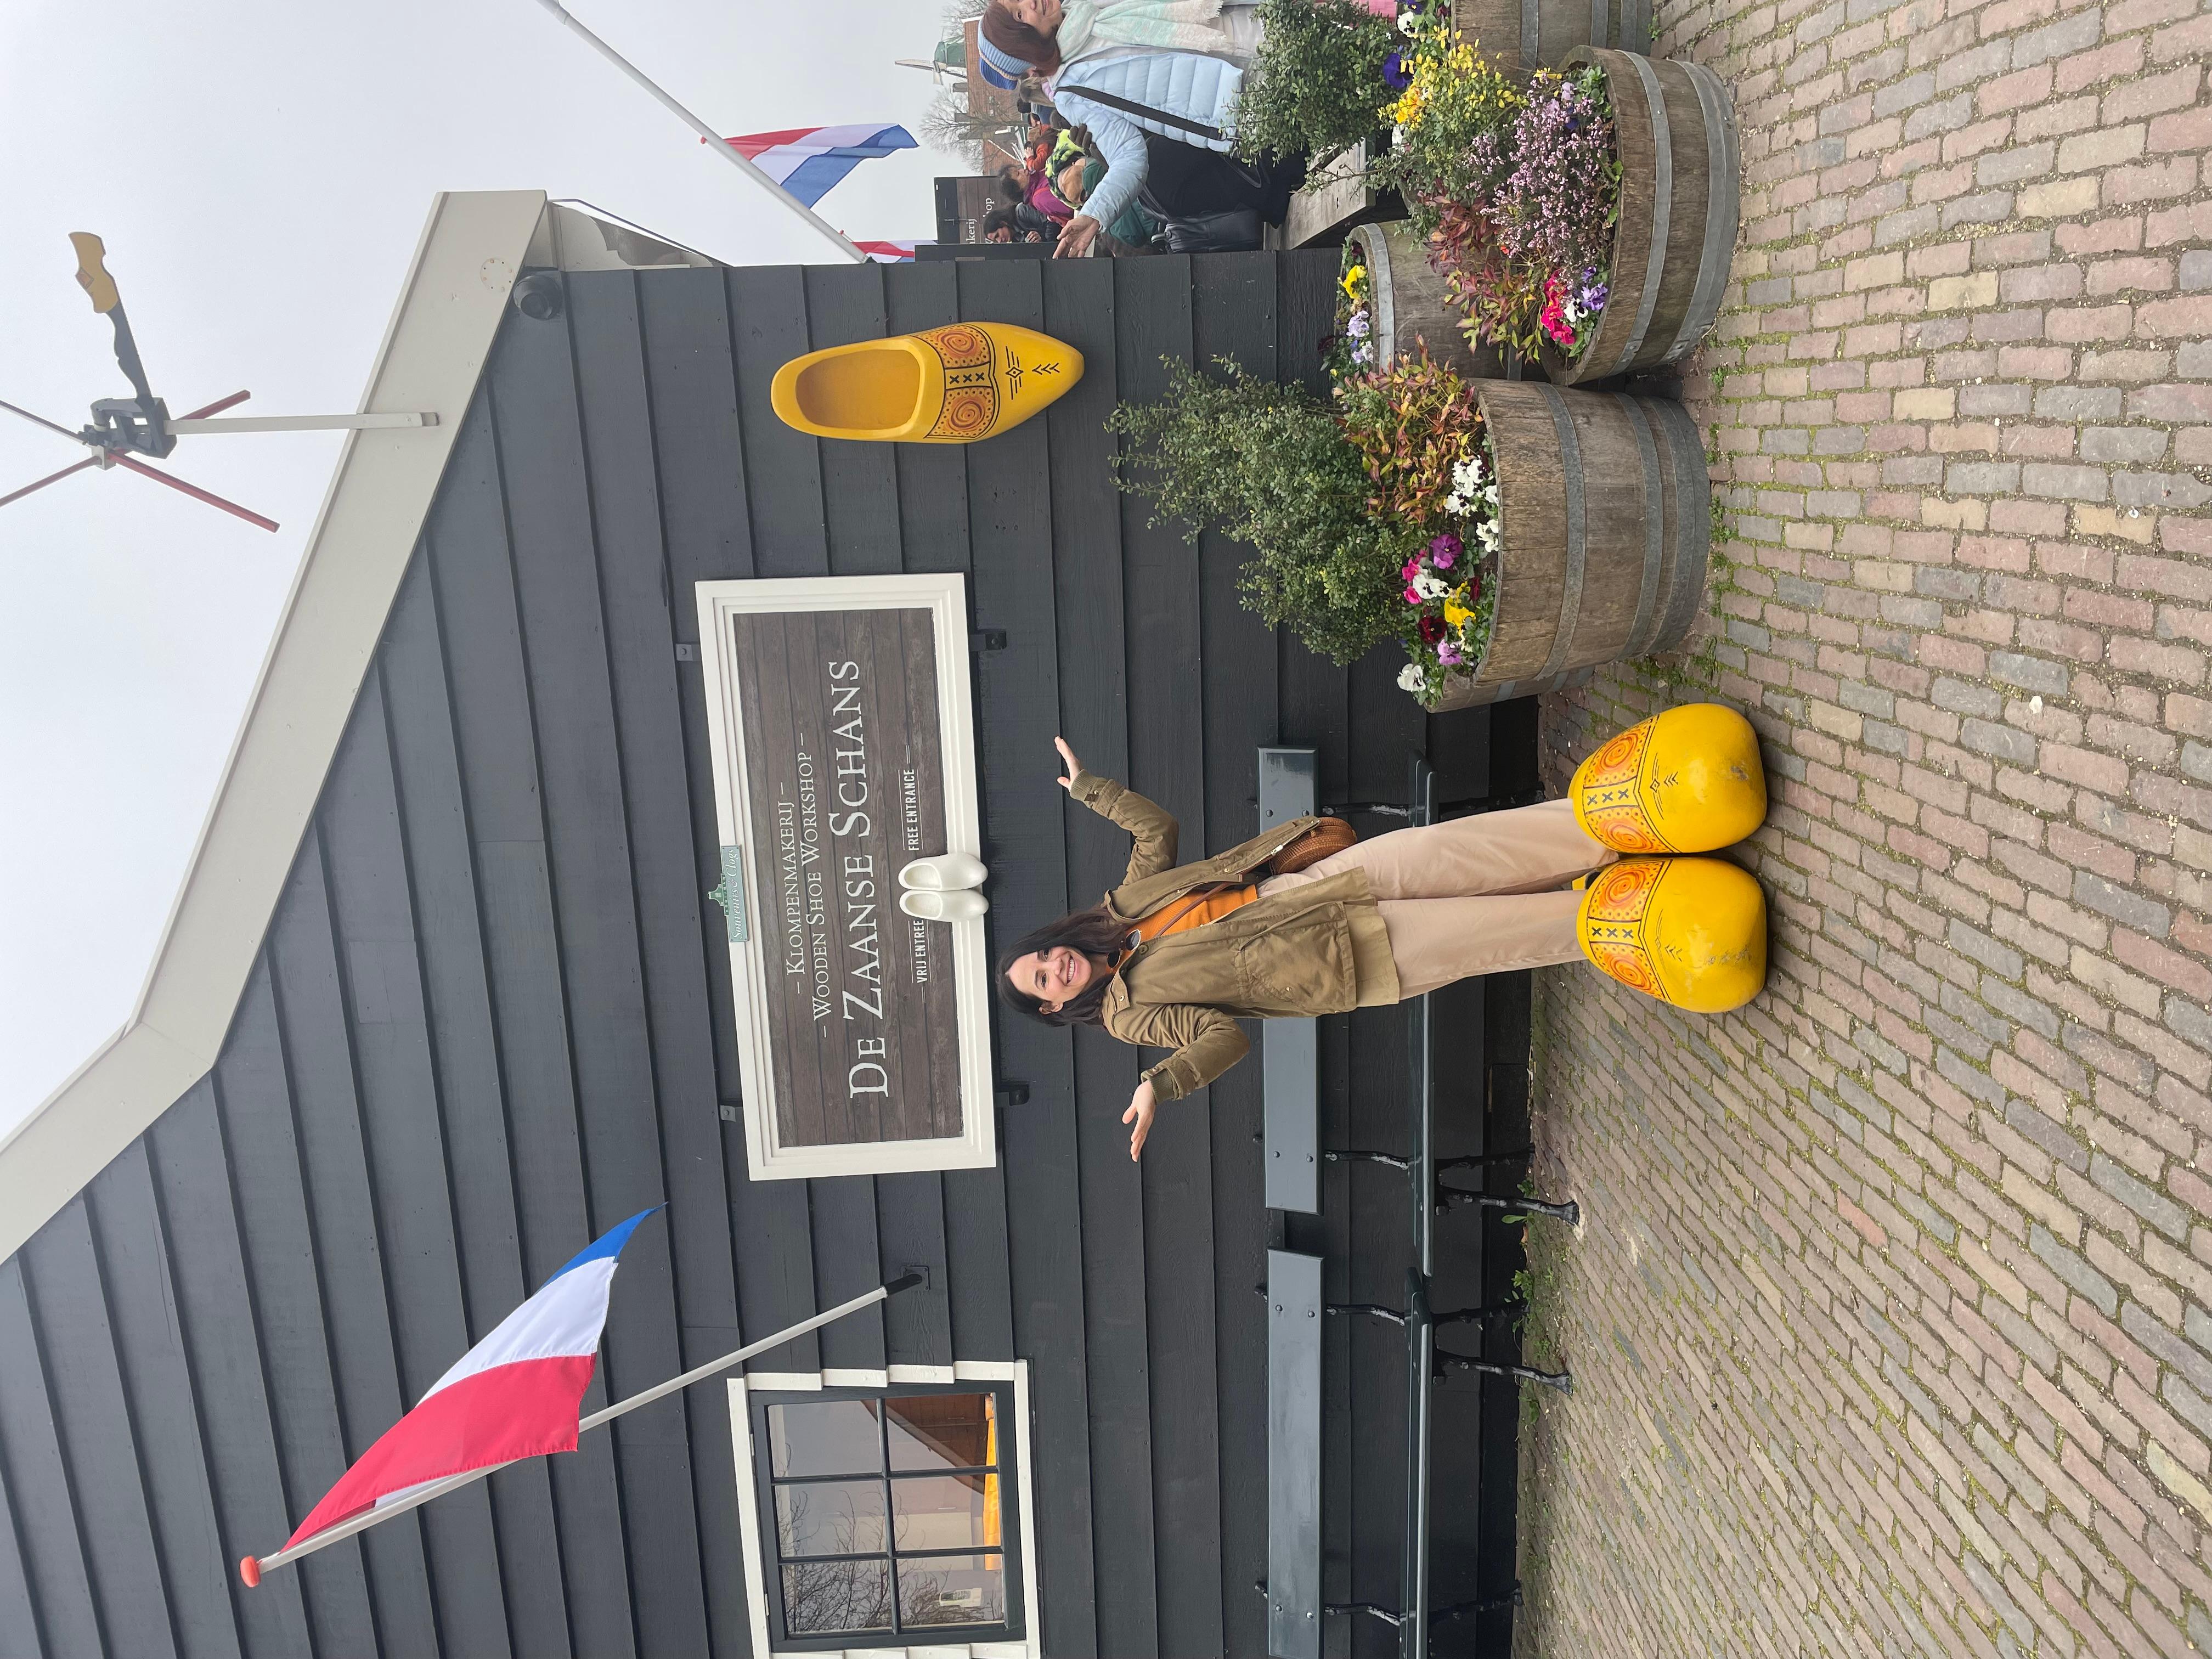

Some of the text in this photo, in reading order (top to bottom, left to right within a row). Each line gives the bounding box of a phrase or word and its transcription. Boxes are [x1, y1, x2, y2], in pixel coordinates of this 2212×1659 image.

[903, 769, 919, 851] FREE ENTRANCE
[725, 850, 738, 877] Clogs
[777, 800, 805, 975] KLOMPENMAKERIJ
[798, 752, 832, 1022] WOODEN SHOE WORKSHOP
[828, 661, 889, 1099] DE ZAANSE SCHANS
[730, 889, 742, 939] Souvenirs
[913, 919, 928, 983] VRIJ ENTREE
